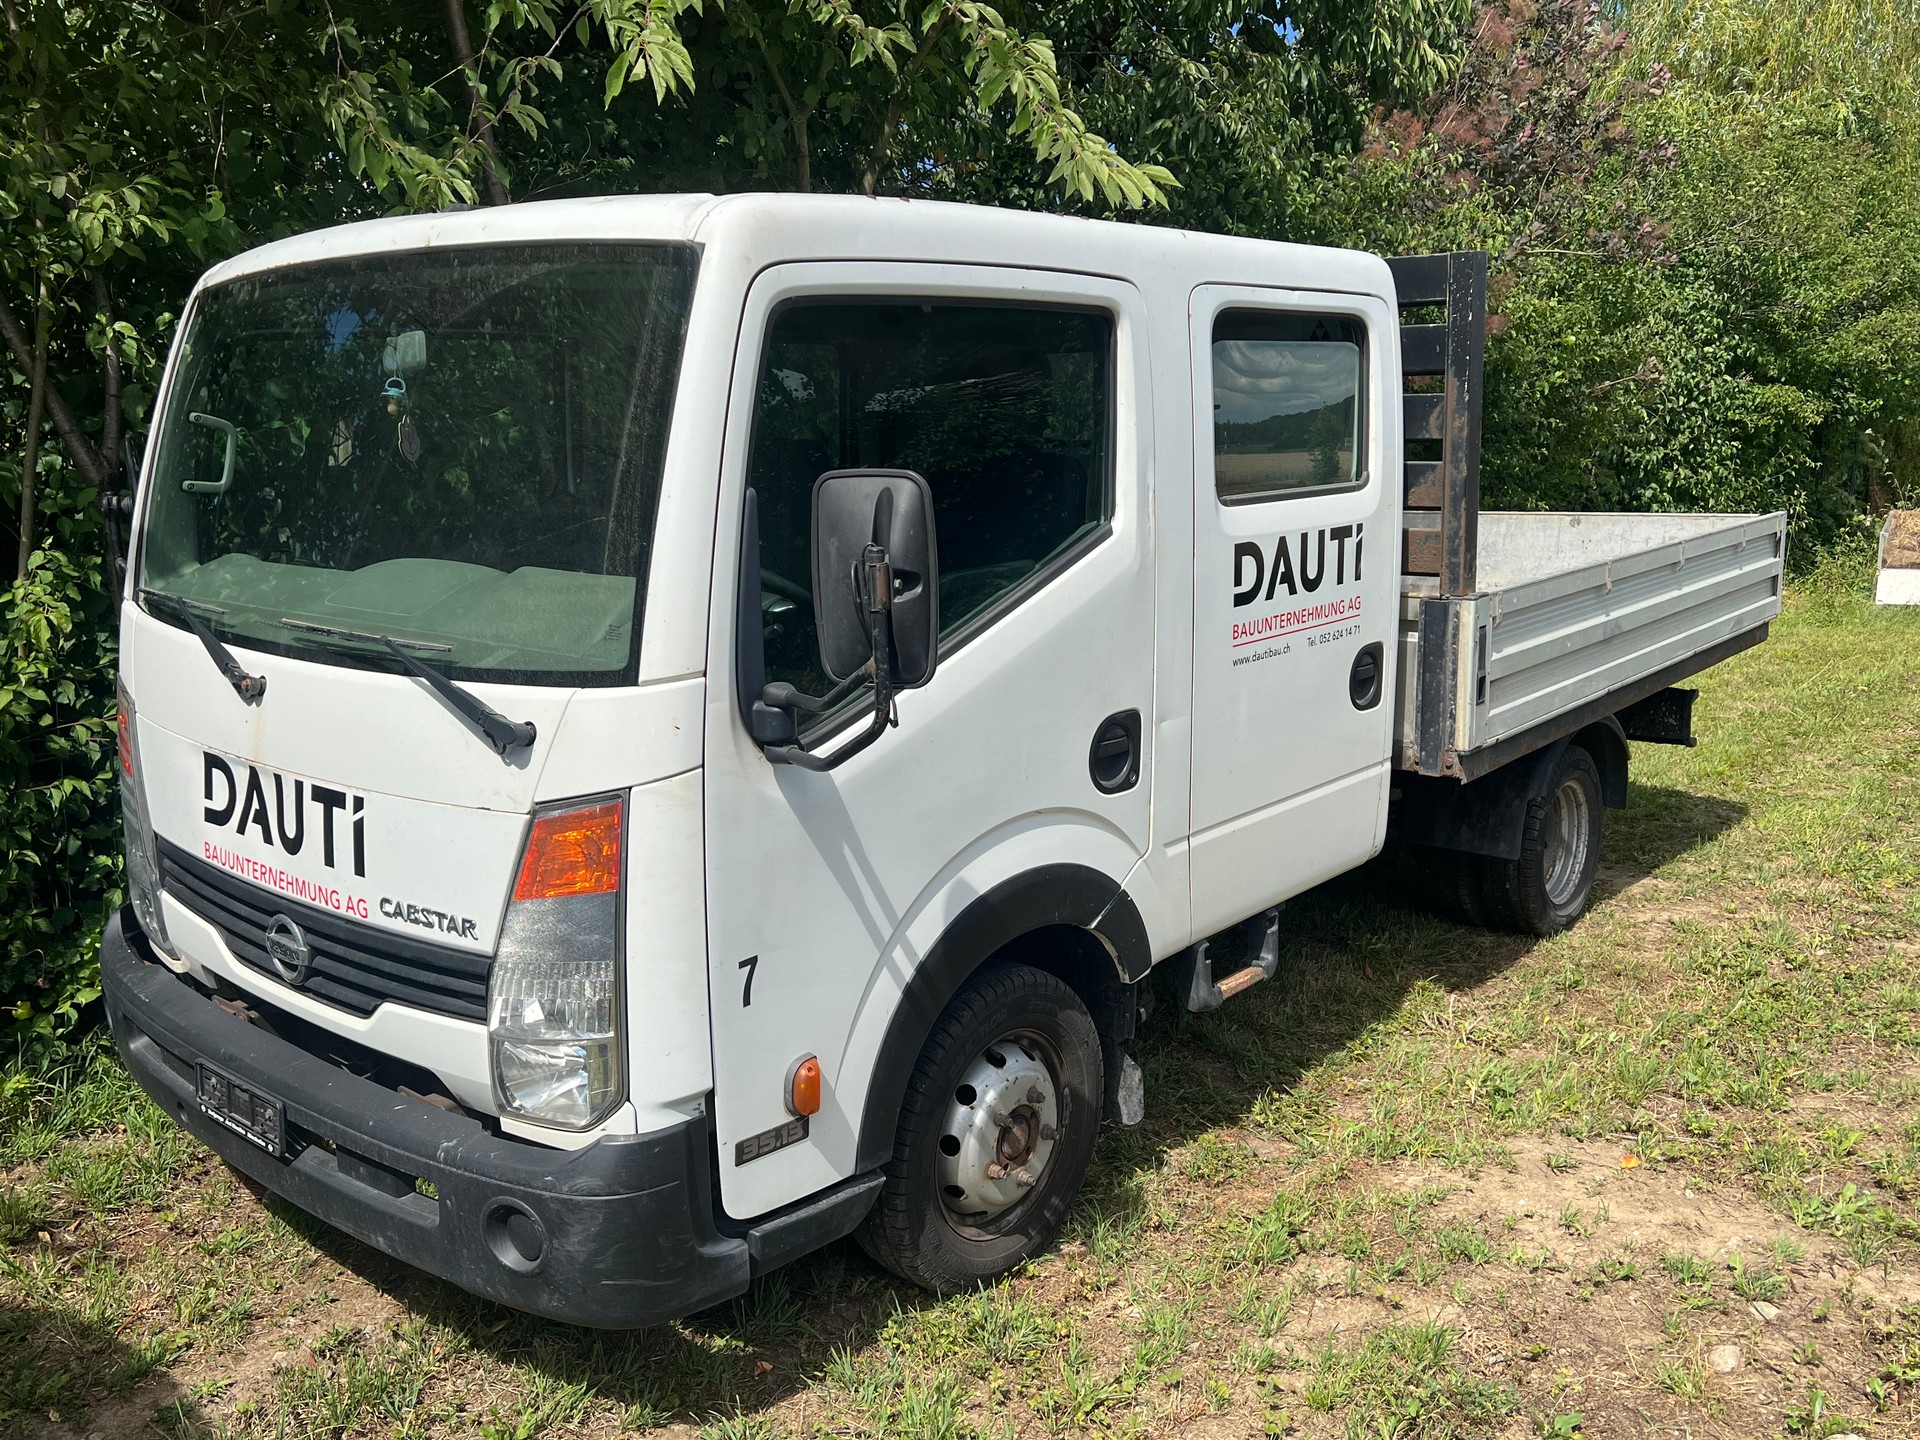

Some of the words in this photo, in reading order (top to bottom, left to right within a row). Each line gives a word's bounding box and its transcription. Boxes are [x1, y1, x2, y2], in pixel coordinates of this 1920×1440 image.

[1232, 600, 1345, 640] BAUUNTERNEHMUNG
[1347, 596, 1361, 611] AG
[1307, 635, 1318, 647] Tel.
[1320, 632, 1331, 645] 052
[1332, 629, 1344, 641] 624
[1345, 626, 1353, 637] 14
[1354, 624, 1361, 635] 71
[1232, 642, 1291, 667] www.dautibau.ch
[204, 841, 341, 910] BAUUNTERNEHMUNG
[346, 895, 369, 919] AG
[379, 897, 479, 941] CABSTAR
[738, 955, 758, 1008] 7
